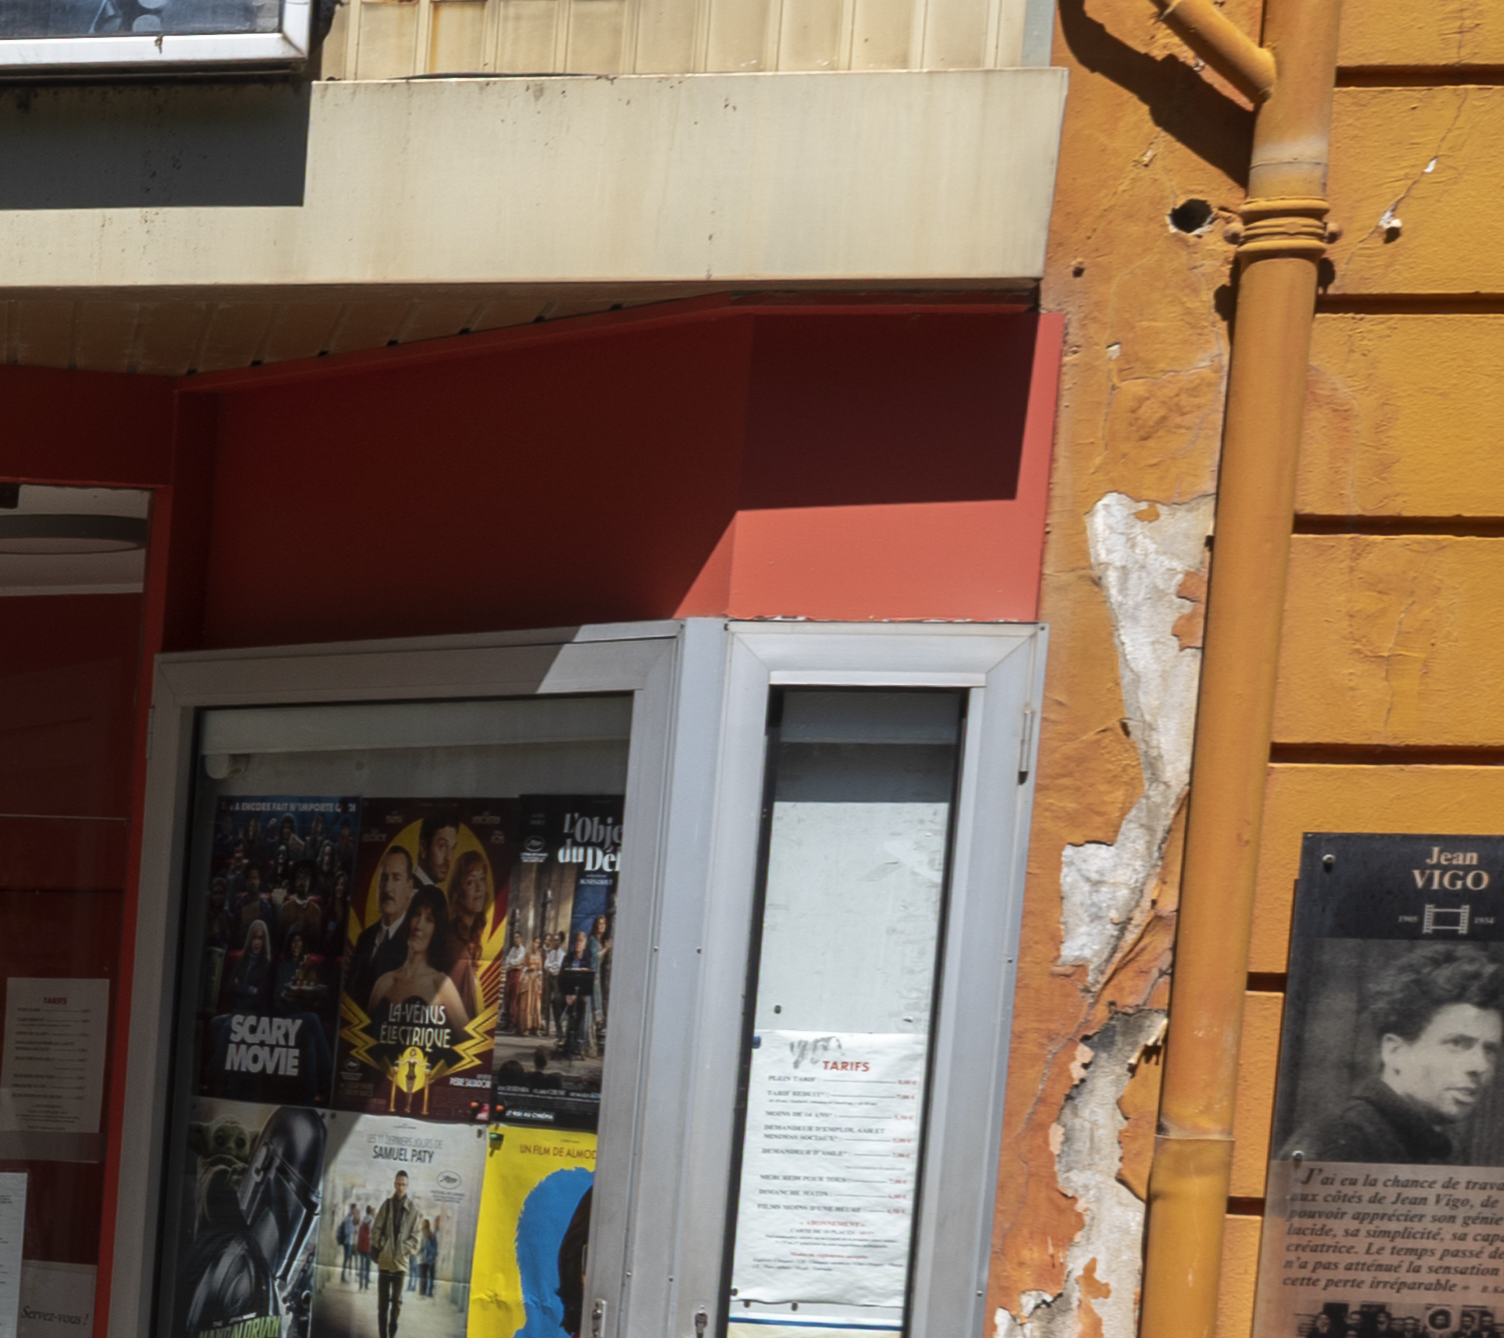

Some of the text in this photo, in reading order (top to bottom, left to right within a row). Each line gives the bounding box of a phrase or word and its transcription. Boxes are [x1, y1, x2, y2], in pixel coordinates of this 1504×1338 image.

[1425, 846, 1478, 865] Jean
[1412, 870, 1489, 890] VIGO
[405, 1001, 446, 1025] VÉNUS
[230, 1014, 302, 1046] SCARY
[380, 1022, 450, 1051] ÉLECTRIQUE
[225, 1043, 299, 1076] MOVIE
[822, 1061, 870, 1072] TARIFS
[373, 1146, 435, 1163] SAMUEL PATY
[533, 1146, 564, 1156] FILM DE
[1340, 1174, 1460, 1190] eu la chance de
[1290, 1190, 1498, 1208] aux côtés de Jean de
[1286, 1208, 1504, 1227] pouvoir apprécier son génie
[1342, 1228, 1468, 1242] sa sa
[1365, 1243, 1484, 1261] Le temps passé
[1312, 1261, 1499, 1276] pas atténué la sensation
[1283, 1277, 1458, 1293] cette perte irréparable
[21, 1305, 81, 1325] Servez-vous
